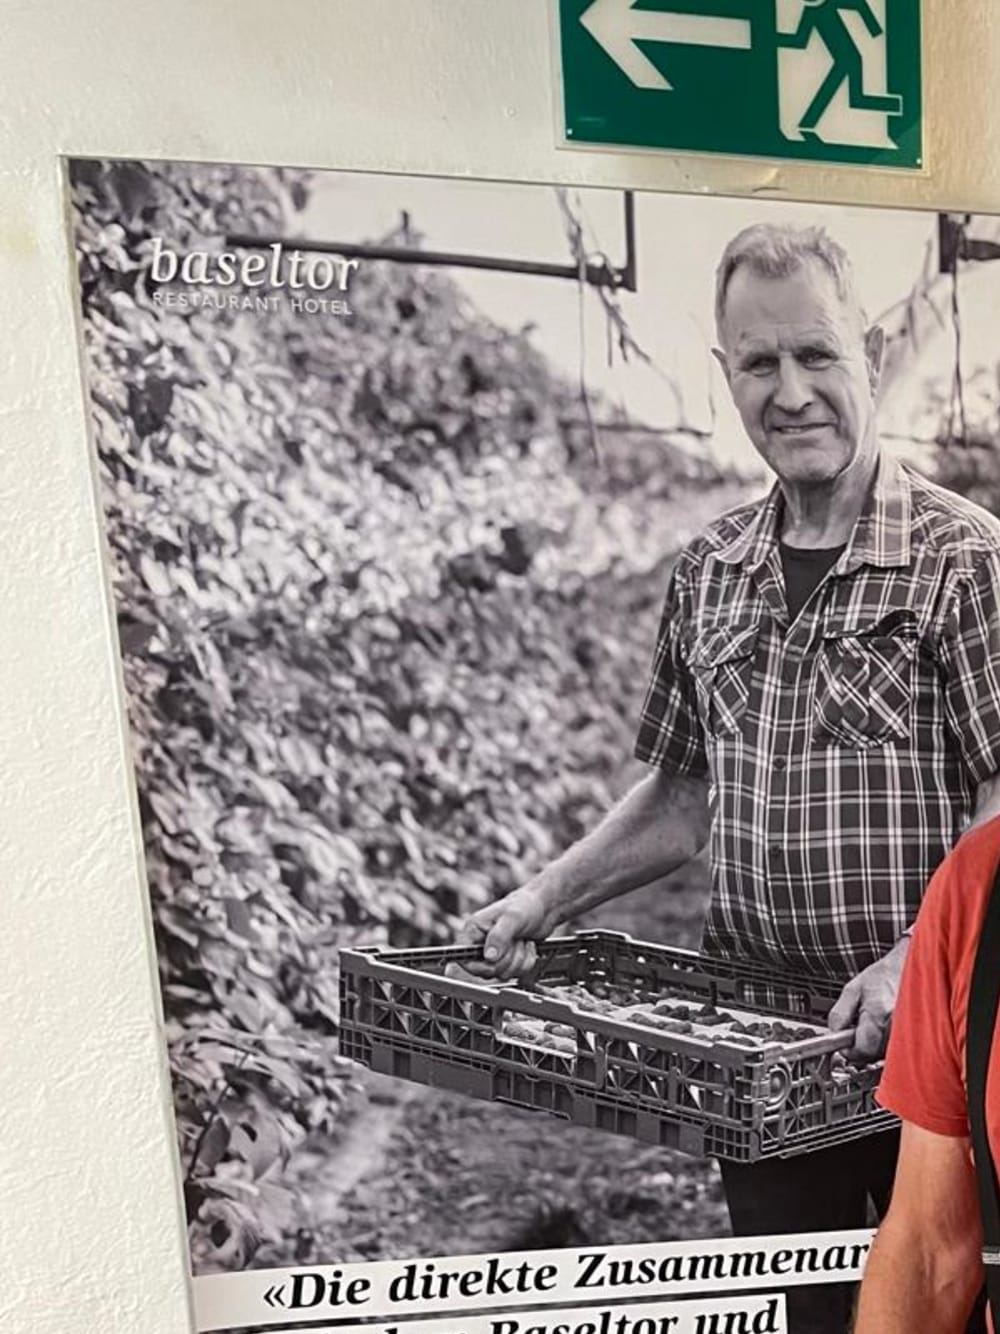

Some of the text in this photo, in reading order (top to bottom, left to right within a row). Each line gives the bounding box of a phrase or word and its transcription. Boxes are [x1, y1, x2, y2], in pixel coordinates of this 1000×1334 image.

[150, 237, 359, 290] baseltor
[153, 292, 353, 315] RESTAURANT HOTEL
[263, 1234, 876, 1309] «Die direkte Zusammenar
